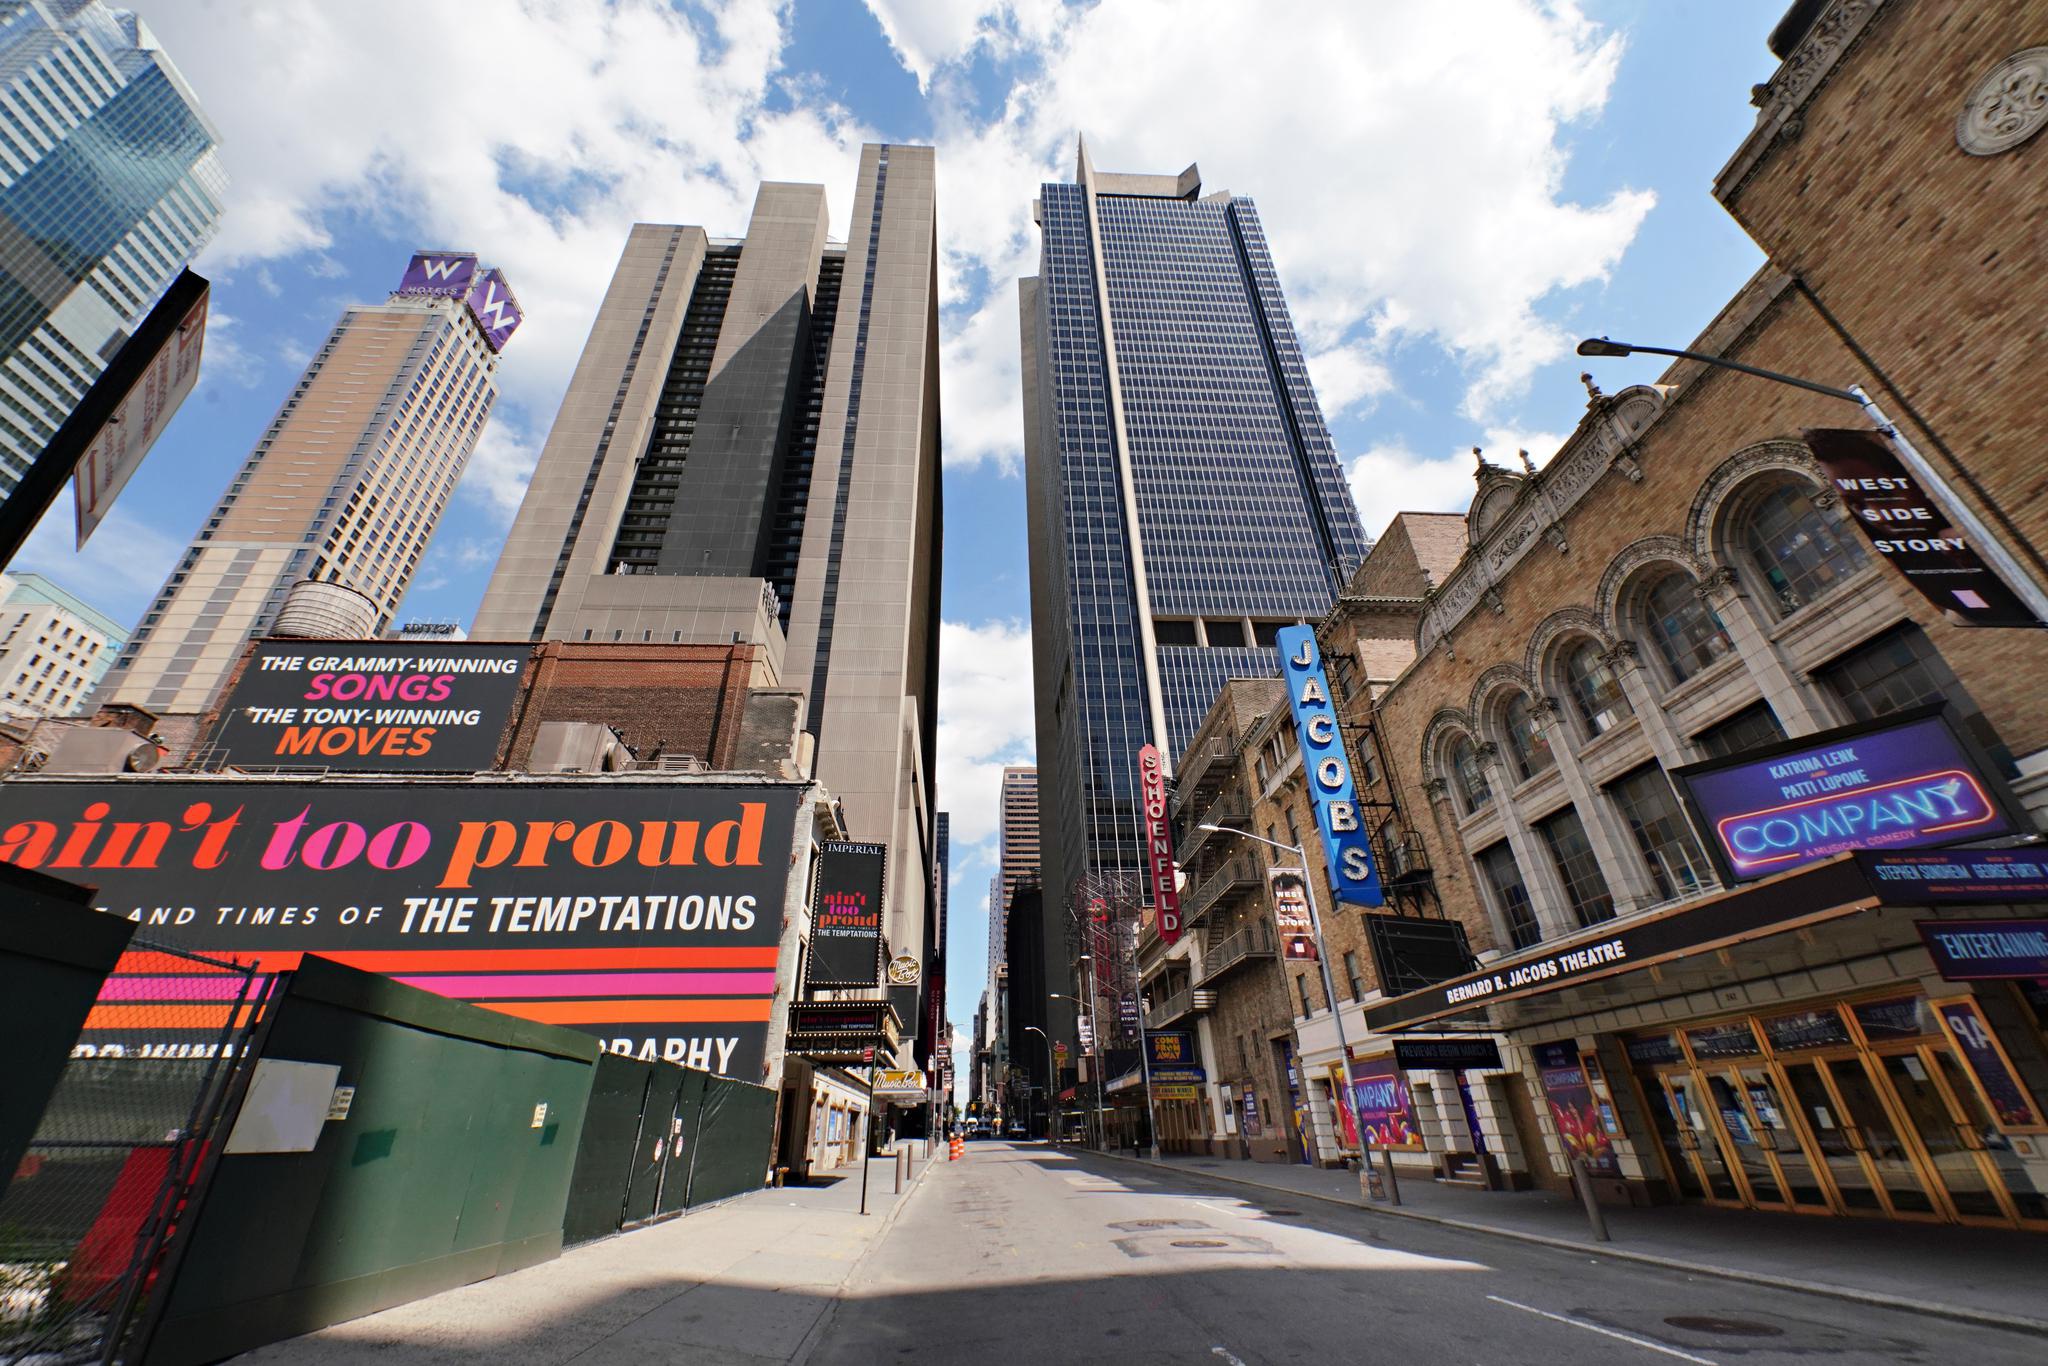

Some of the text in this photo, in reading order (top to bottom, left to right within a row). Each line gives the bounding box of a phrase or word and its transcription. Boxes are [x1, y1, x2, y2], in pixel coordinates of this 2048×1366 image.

[424, 259, 462, 280] W
[408, 286, 458, 294] HOTELS
[483, 280, 515, 330] W
[1836, 477, 1909, 491] WEST
[1862, 507, 1933, 522] SIDE
[1874, 537, 1966, 553] STORY
[401, 623, 458, 634] EDITION
[260, 656, 519, 674] THE GRAMMY-WINNING
[303, 673, 457, 702] SONGS
[251, 707, 481, 726] THE TONY-WINNING
[274, 726, 437, 756] MOVES
[1291, 639, 1369, 881] JACOBS
[1769, 748, 1859, 779] KATRINA LENK
[1781, 769, 1870, 800] PATTI LUPONE
[1733, 778, 1968, 853] COMPANY
[0, 801, 767, 889] ain't too proud
[828, 843, 881, 855] IMPERIAL
[1144, 753, 1179, 931] SCHOENFELD
[1805, 829, 1917, 857] A MUSICAL COMEDY
[1874, 865, 1922, 880] STEPHEN
[823, 890, 867, 906] ain't
[1276, 891, 1304, 899] WEST
[217, 907, 320, 925] TIMES
[339, 906, 384, 925] OF
[400, 897, 479, 934] THE
[488, 895, 757, 934] TEMPTATIONS
[829, 903, 860, 916] too
[818, 912, 878, 929] proud
[817, 929, 878, 938] THE TEMPTATIONS
[1446, 939, 1627, 1004] BERNARD B. JACOBS THEATRE
[1154, 1036, 1180, 1044] COME
[1155, 1044, 1180, 1052] FROM
[1156, 1051, 1180, 1060] AWAY
[1400, 1044, 1439, 1057] PREVIEWS
[873, 1069, 919, 1089] Music Box
